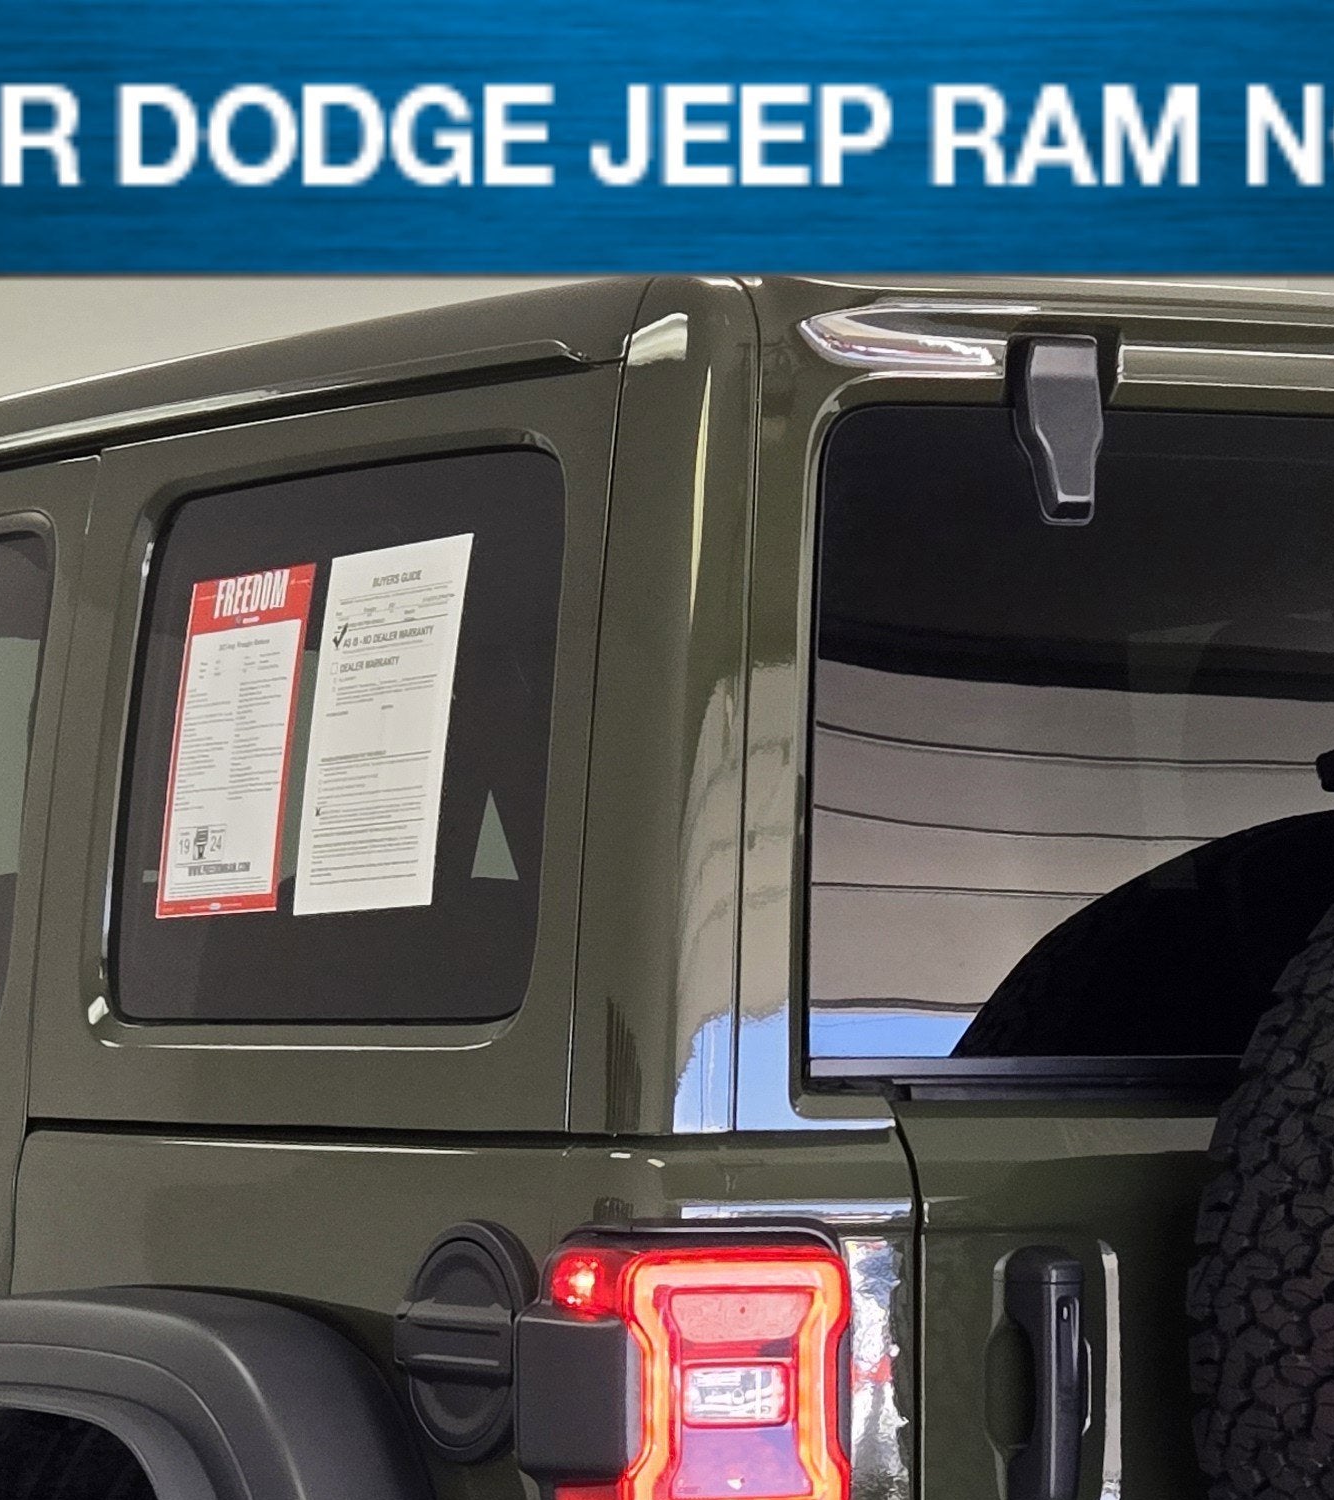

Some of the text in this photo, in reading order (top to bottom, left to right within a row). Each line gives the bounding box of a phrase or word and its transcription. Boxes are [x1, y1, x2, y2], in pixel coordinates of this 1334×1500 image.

[401, 570, 422, 582] GUIDE
[214, 568, 291, 619] FREEDOM
[373, 630, 398, 643] DEALER
[340, 660, 364, 673] DEALER
[178, 834, 222, 855] 19 24
